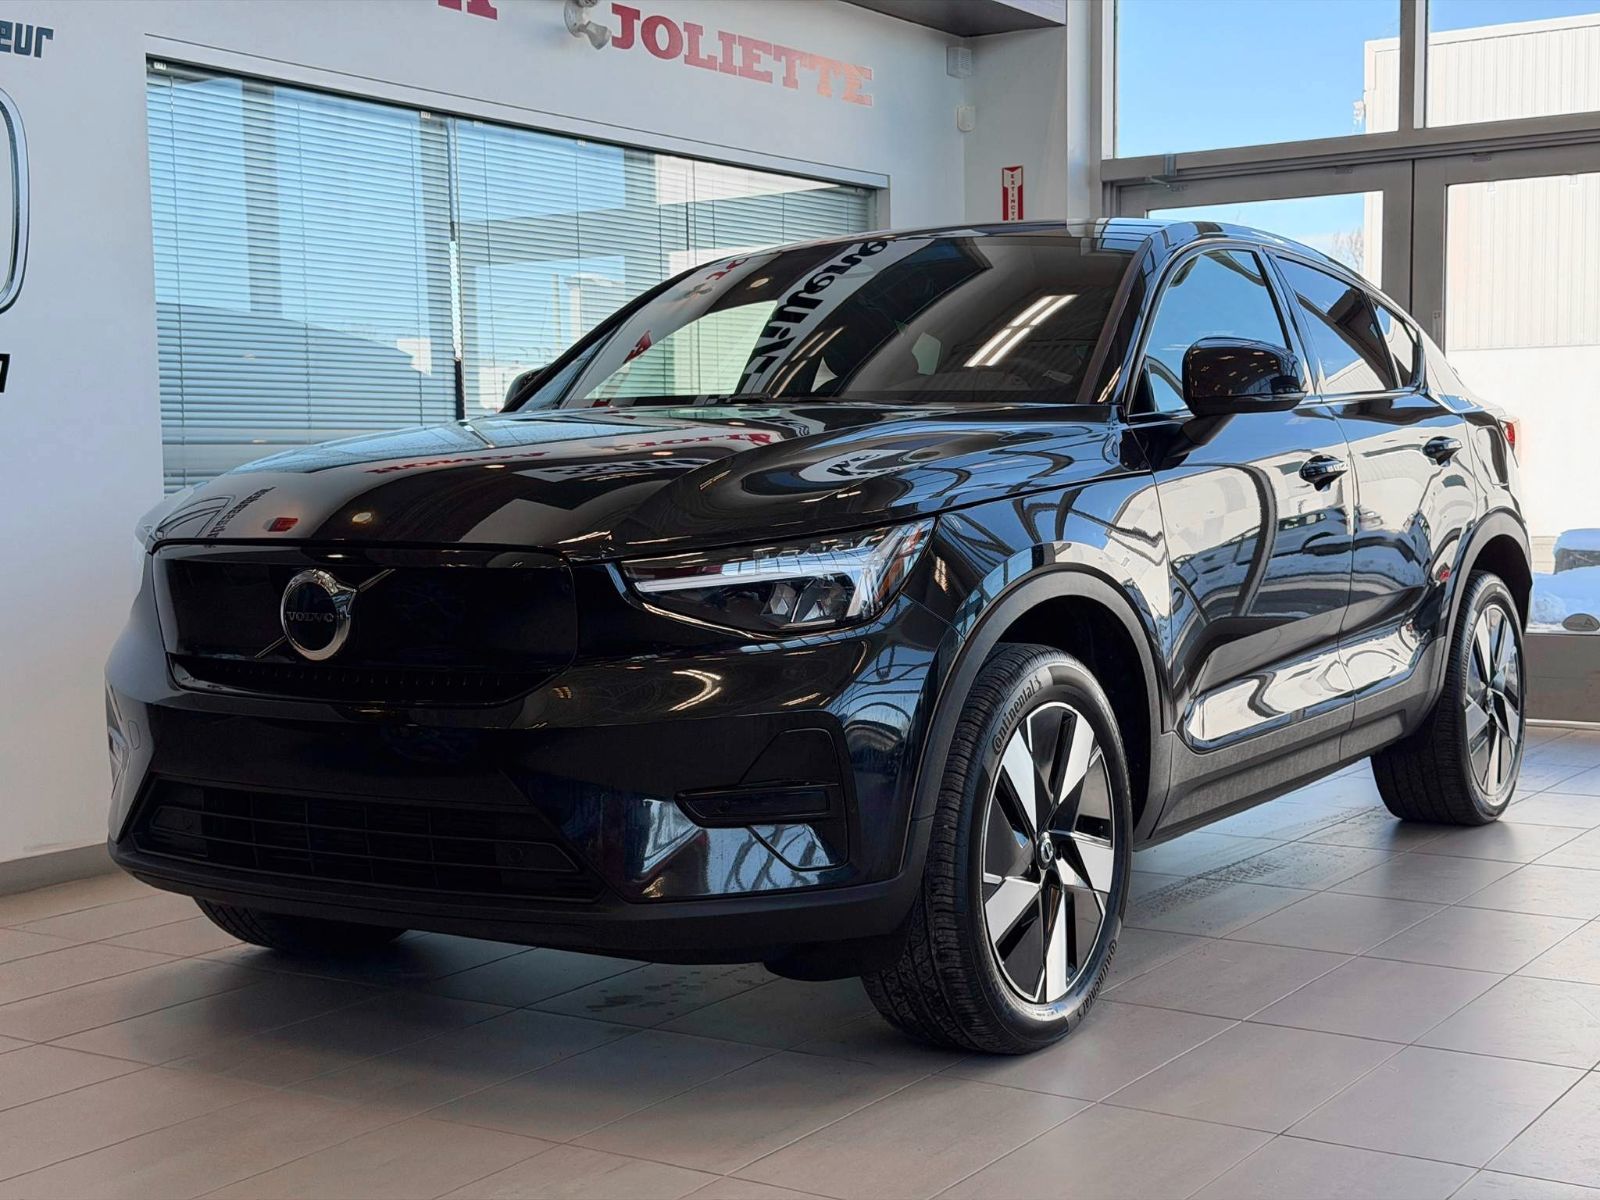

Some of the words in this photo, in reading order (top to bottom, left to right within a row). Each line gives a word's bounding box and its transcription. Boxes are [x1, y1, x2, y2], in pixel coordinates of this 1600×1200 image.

[611, 3, 872, 106] JOLIETTE
[286, 611, 335, 623] VOLVO
[993, 680, 1036, 755] Continental
